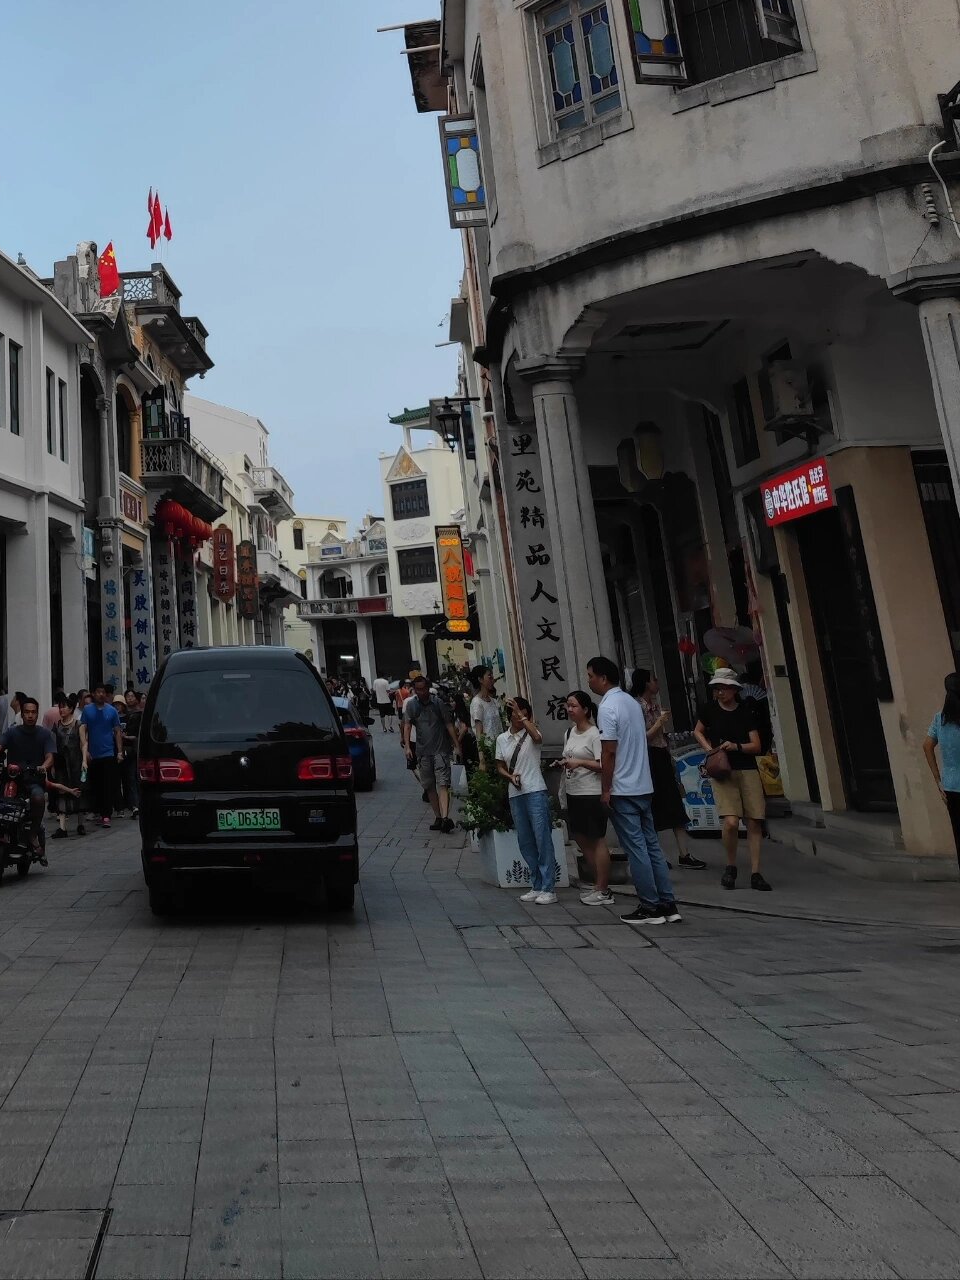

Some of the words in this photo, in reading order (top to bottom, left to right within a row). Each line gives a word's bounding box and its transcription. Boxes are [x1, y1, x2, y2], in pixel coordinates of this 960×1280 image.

[511, 433, 569, 721] 里苑精品人文民宿
